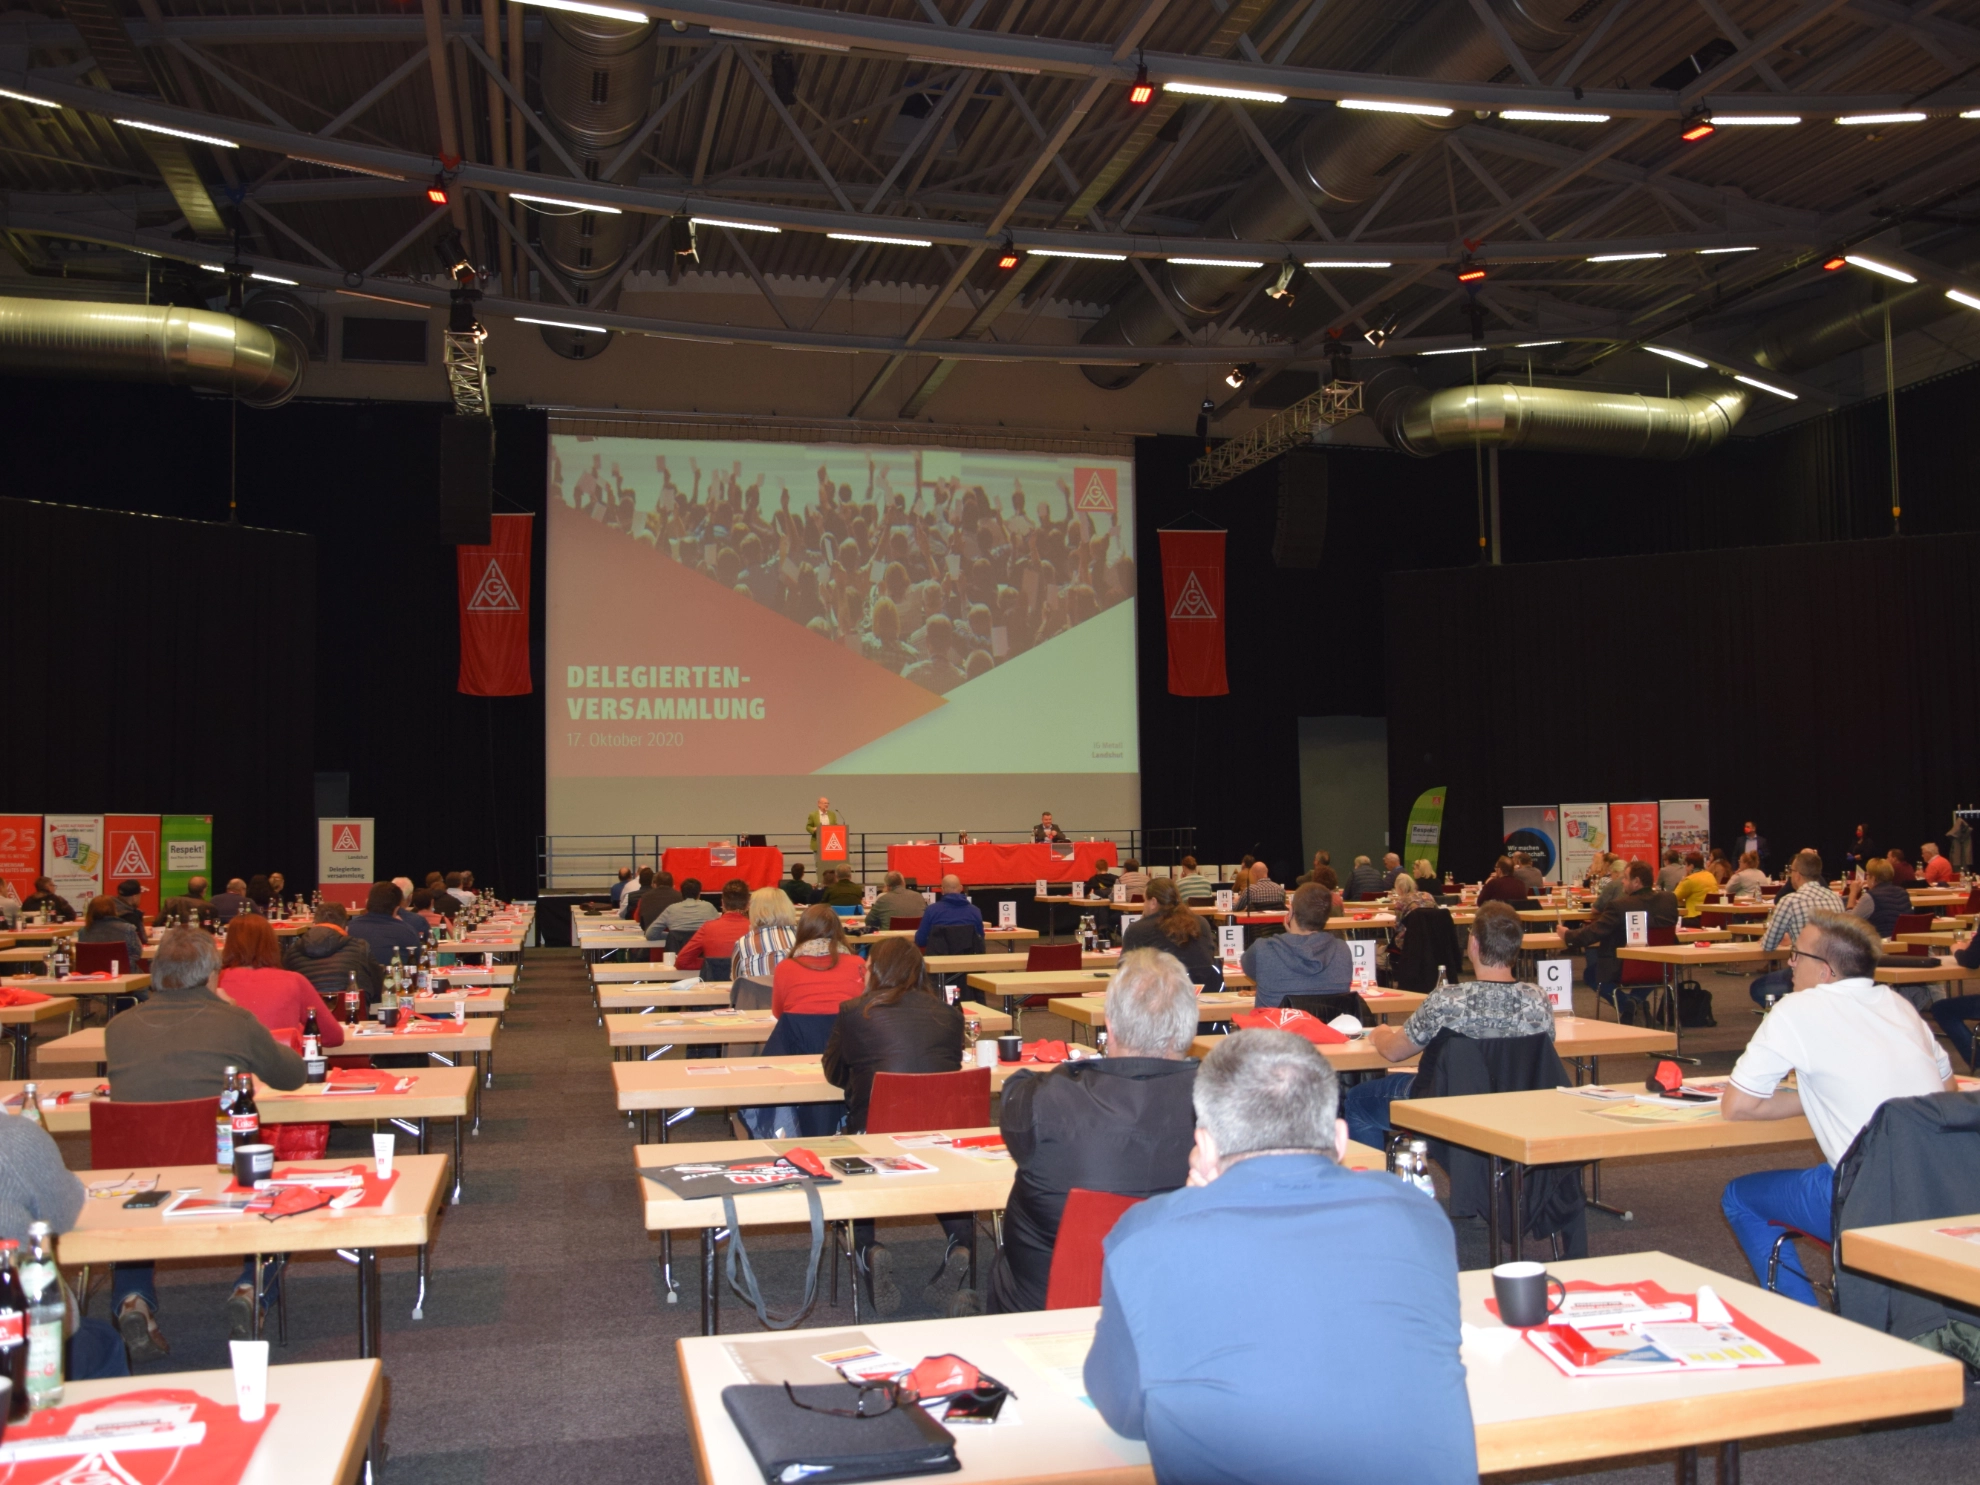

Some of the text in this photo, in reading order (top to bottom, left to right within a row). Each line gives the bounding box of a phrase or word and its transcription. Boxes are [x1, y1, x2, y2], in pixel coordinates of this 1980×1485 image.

[567, 665, 751, 688] DELEGIERTEN-
[566, 697, 766, 720] VERSAMMLUNG
[566, 731, 684, 747] 17. Oktober 2020
[170, 844, 205, 855] Respekt!
[1002, 904, 1009, 912] G
[1632, 915, 1639, 925] E
[1226, 929, 1234, 940] E
[1354, 944, 1365, 958] D
[1547, 965, 1559, 982] C
[235, 1119, 255, 1128] Coke
